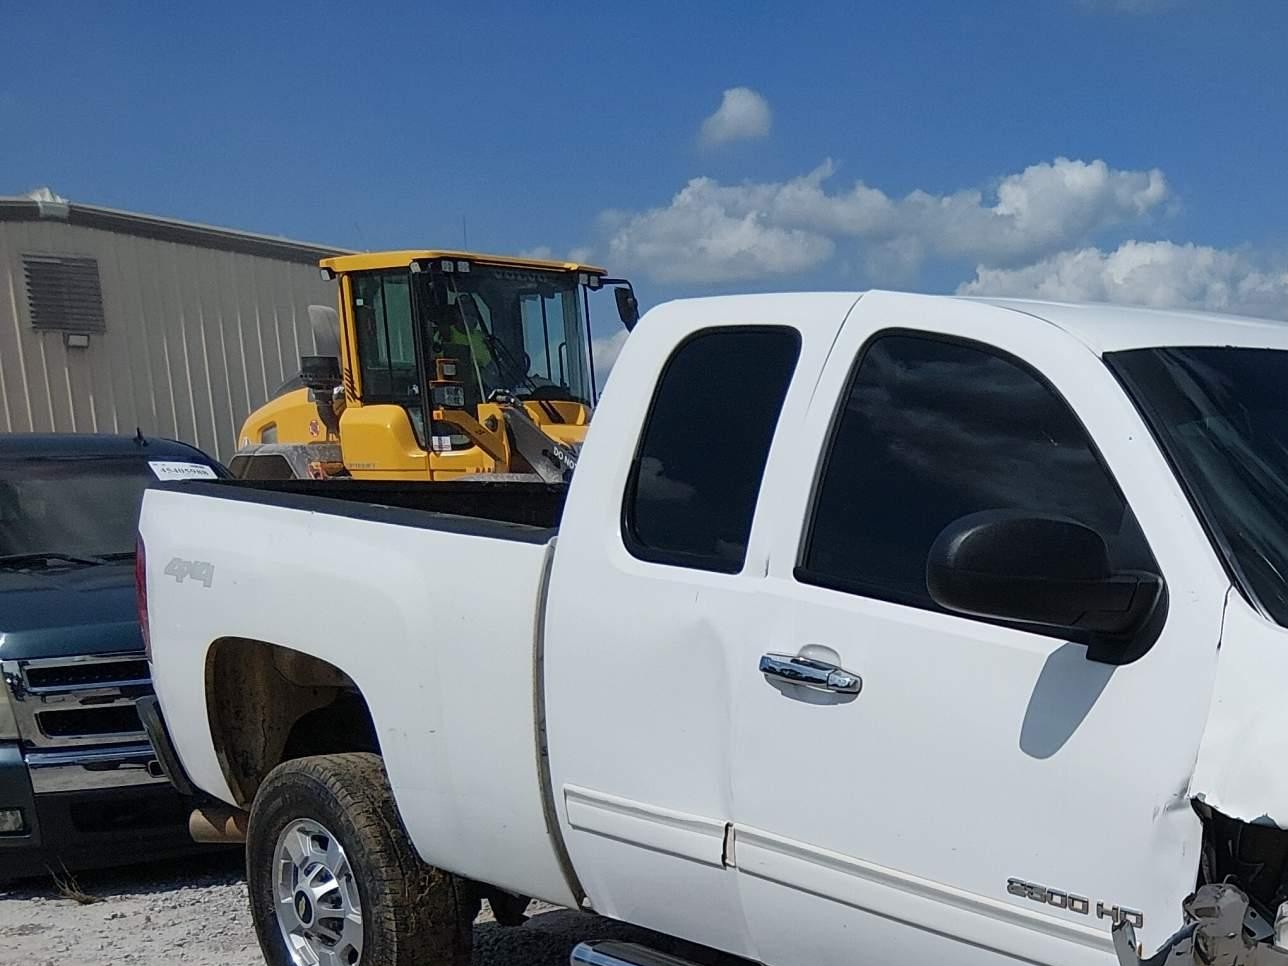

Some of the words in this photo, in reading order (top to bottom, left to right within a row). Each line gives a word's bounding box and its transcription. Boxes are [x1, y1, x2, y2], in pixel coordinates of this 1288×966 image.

[554, 446, 564, 460] DO
[564, 456, 578, 469] NO
[1006, 876, 1090, 916] 2500
[1096, 899, 1144, 929] HD
